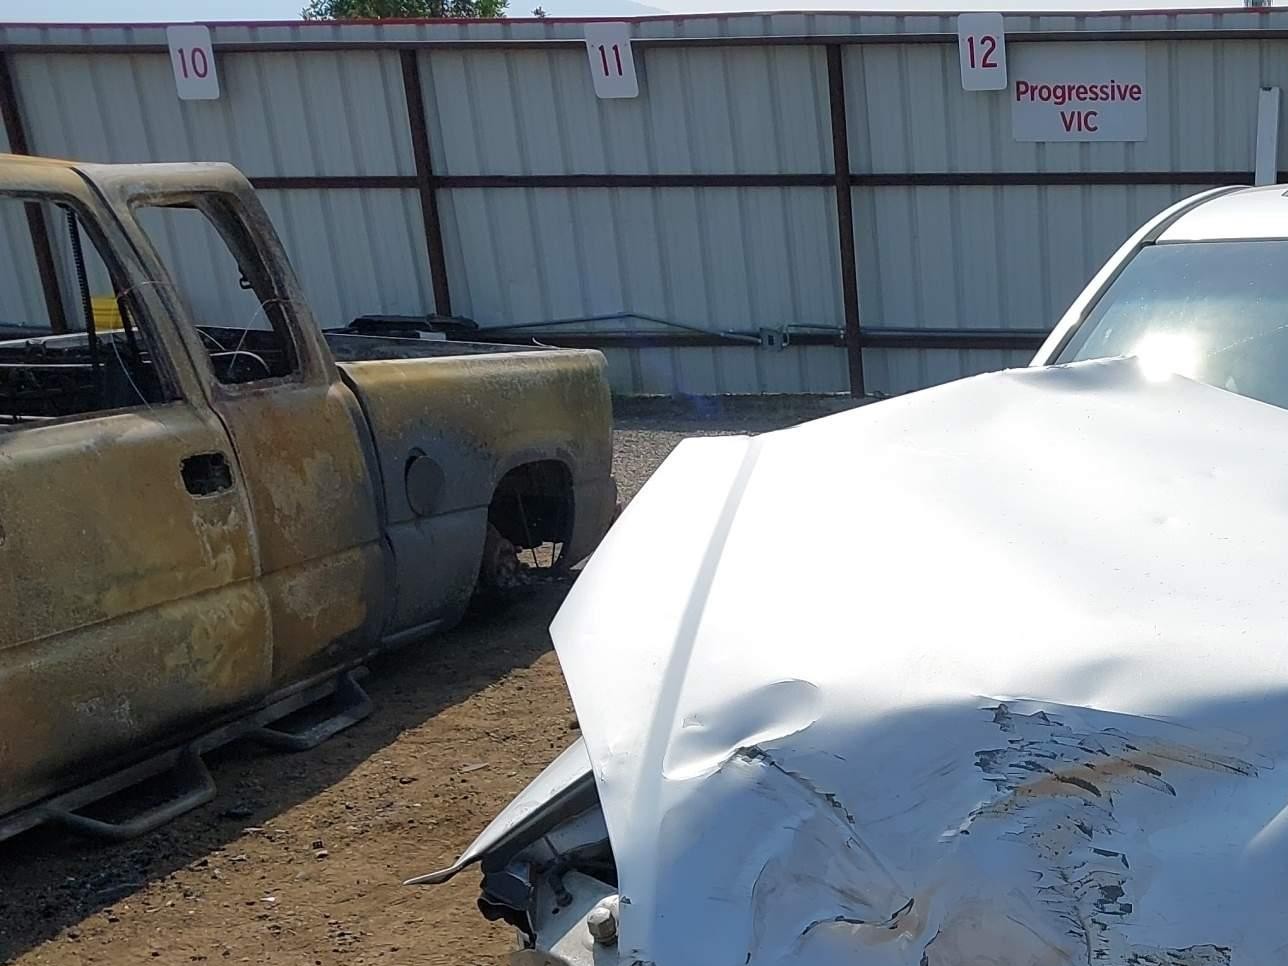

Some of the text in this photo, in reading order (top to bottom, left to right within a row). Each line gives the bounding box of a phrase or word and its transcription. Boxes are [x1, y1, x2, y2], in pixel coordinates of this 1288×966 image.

[177, 47, 208, 79] 10
[598, 44, 623, 77] 11
[966, 35, 999, 69] 12
[1014, 79, 1143, 106] Progressive
[1059, 110, 1099, 133] VIC
